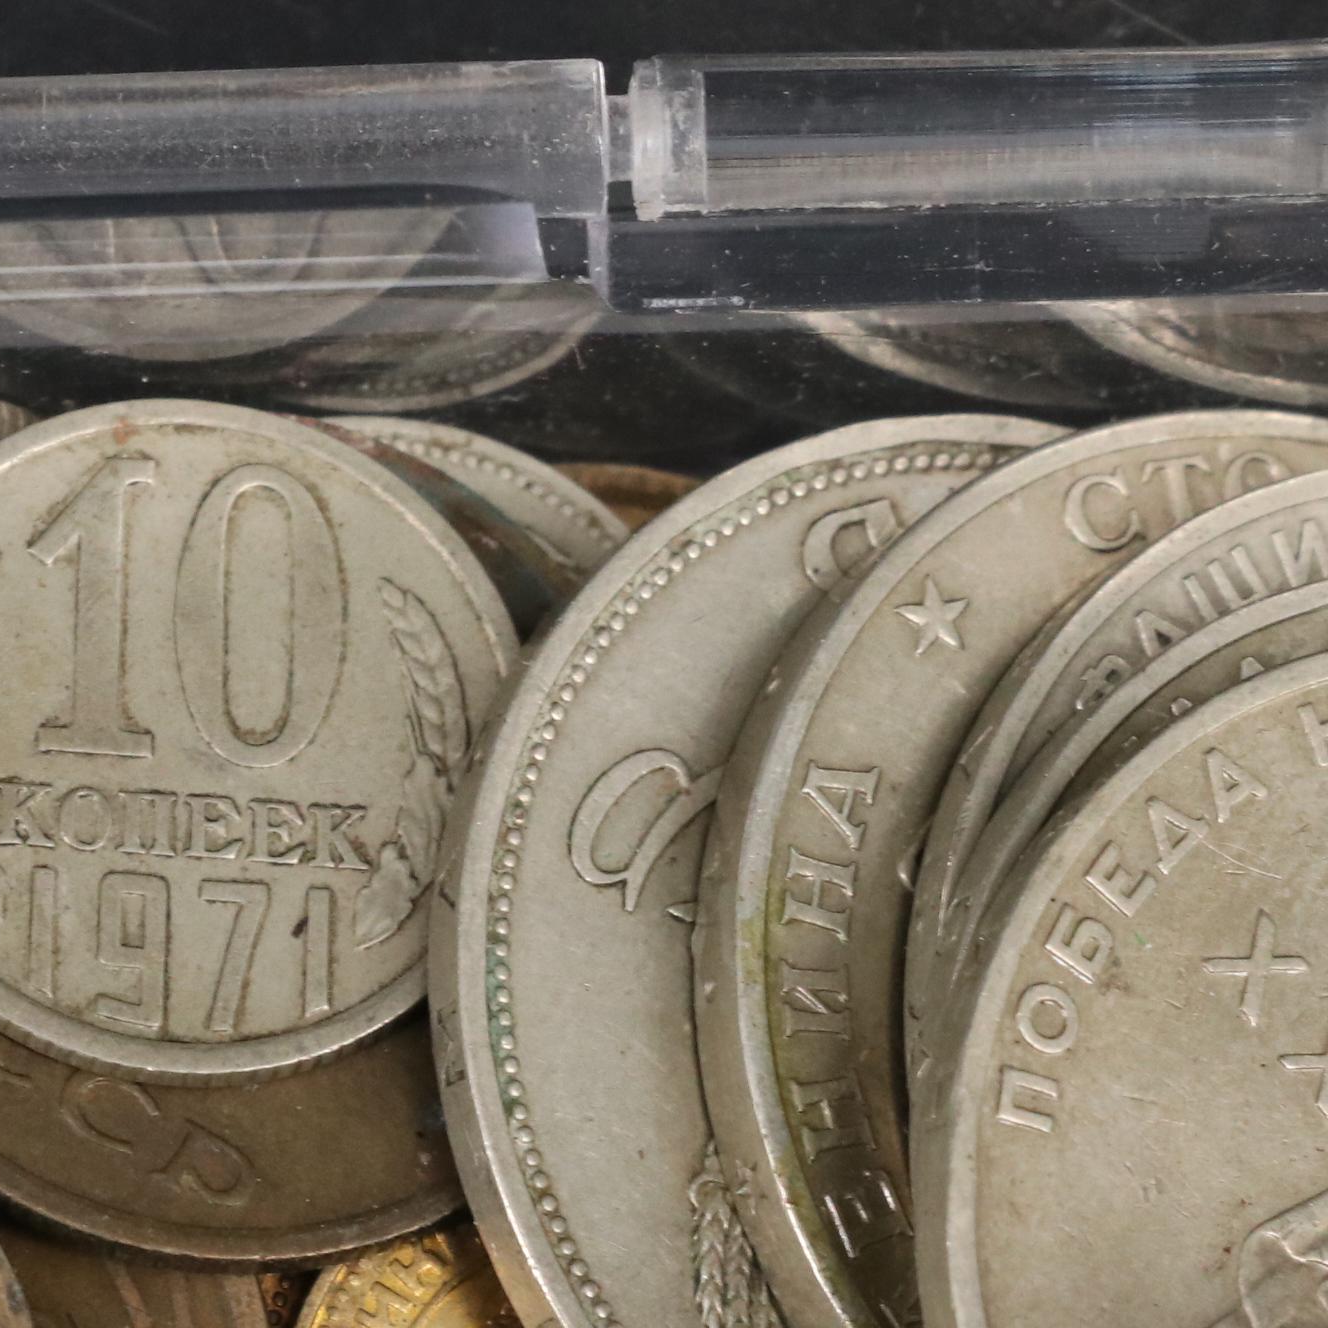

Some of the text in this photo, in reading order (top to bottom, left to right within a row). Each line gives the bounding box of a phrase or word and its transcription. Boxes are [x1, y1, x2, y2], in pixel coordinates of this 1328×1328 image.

[24, 453, 349, 770] 10
[24, 864, 336, 1033] 1971
[779, 759, 916, 1325] ЕНИНА
[997, 745, 1269, 1134] ПОБЕДА
